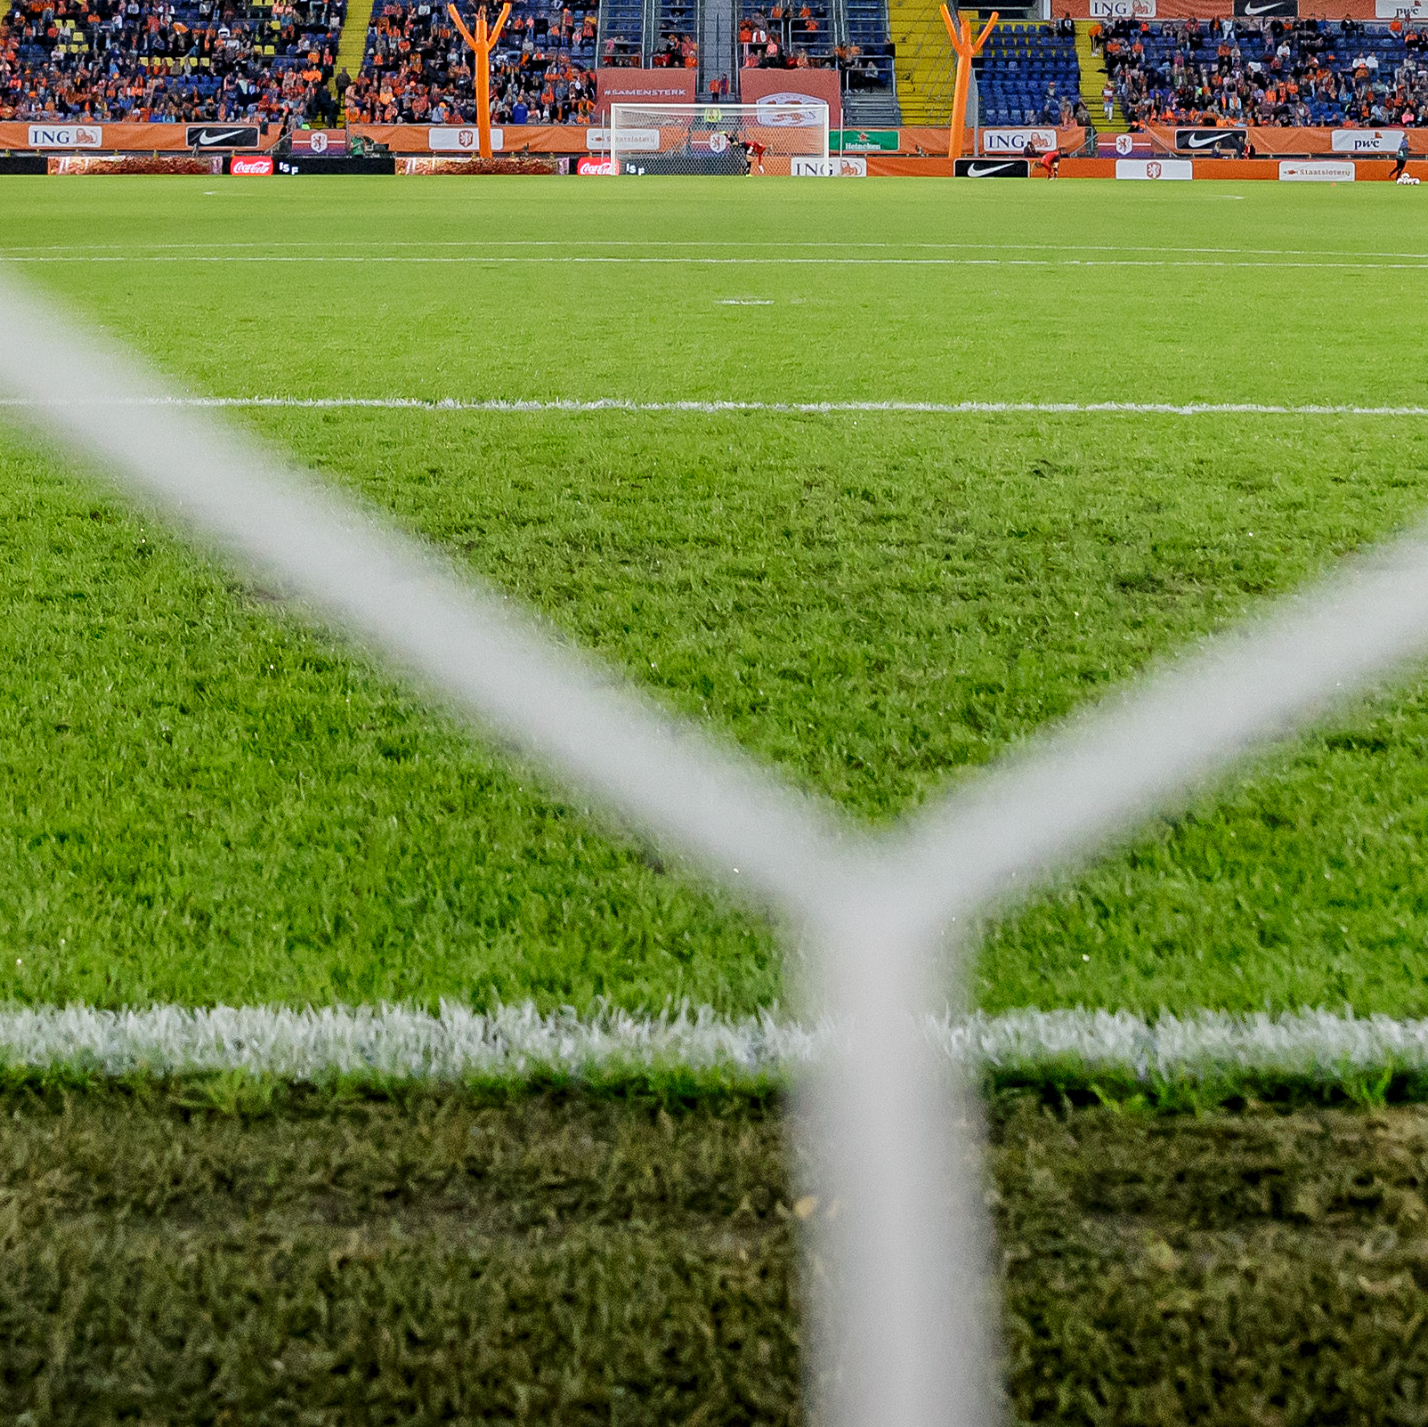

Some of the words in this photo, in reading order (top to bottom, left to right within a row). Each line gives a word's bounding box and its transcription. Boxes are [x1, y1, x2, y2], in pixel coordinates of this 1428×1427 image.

[1094, 2, 1126, 14] ING
[33, 130, 70, 145] ING
[988, 134, 1026, 149] ING
[845, 142, 881, 151] Heineken
[1354, 138, 1379, 152] pwc
[797, 163, 833, 176] ING
